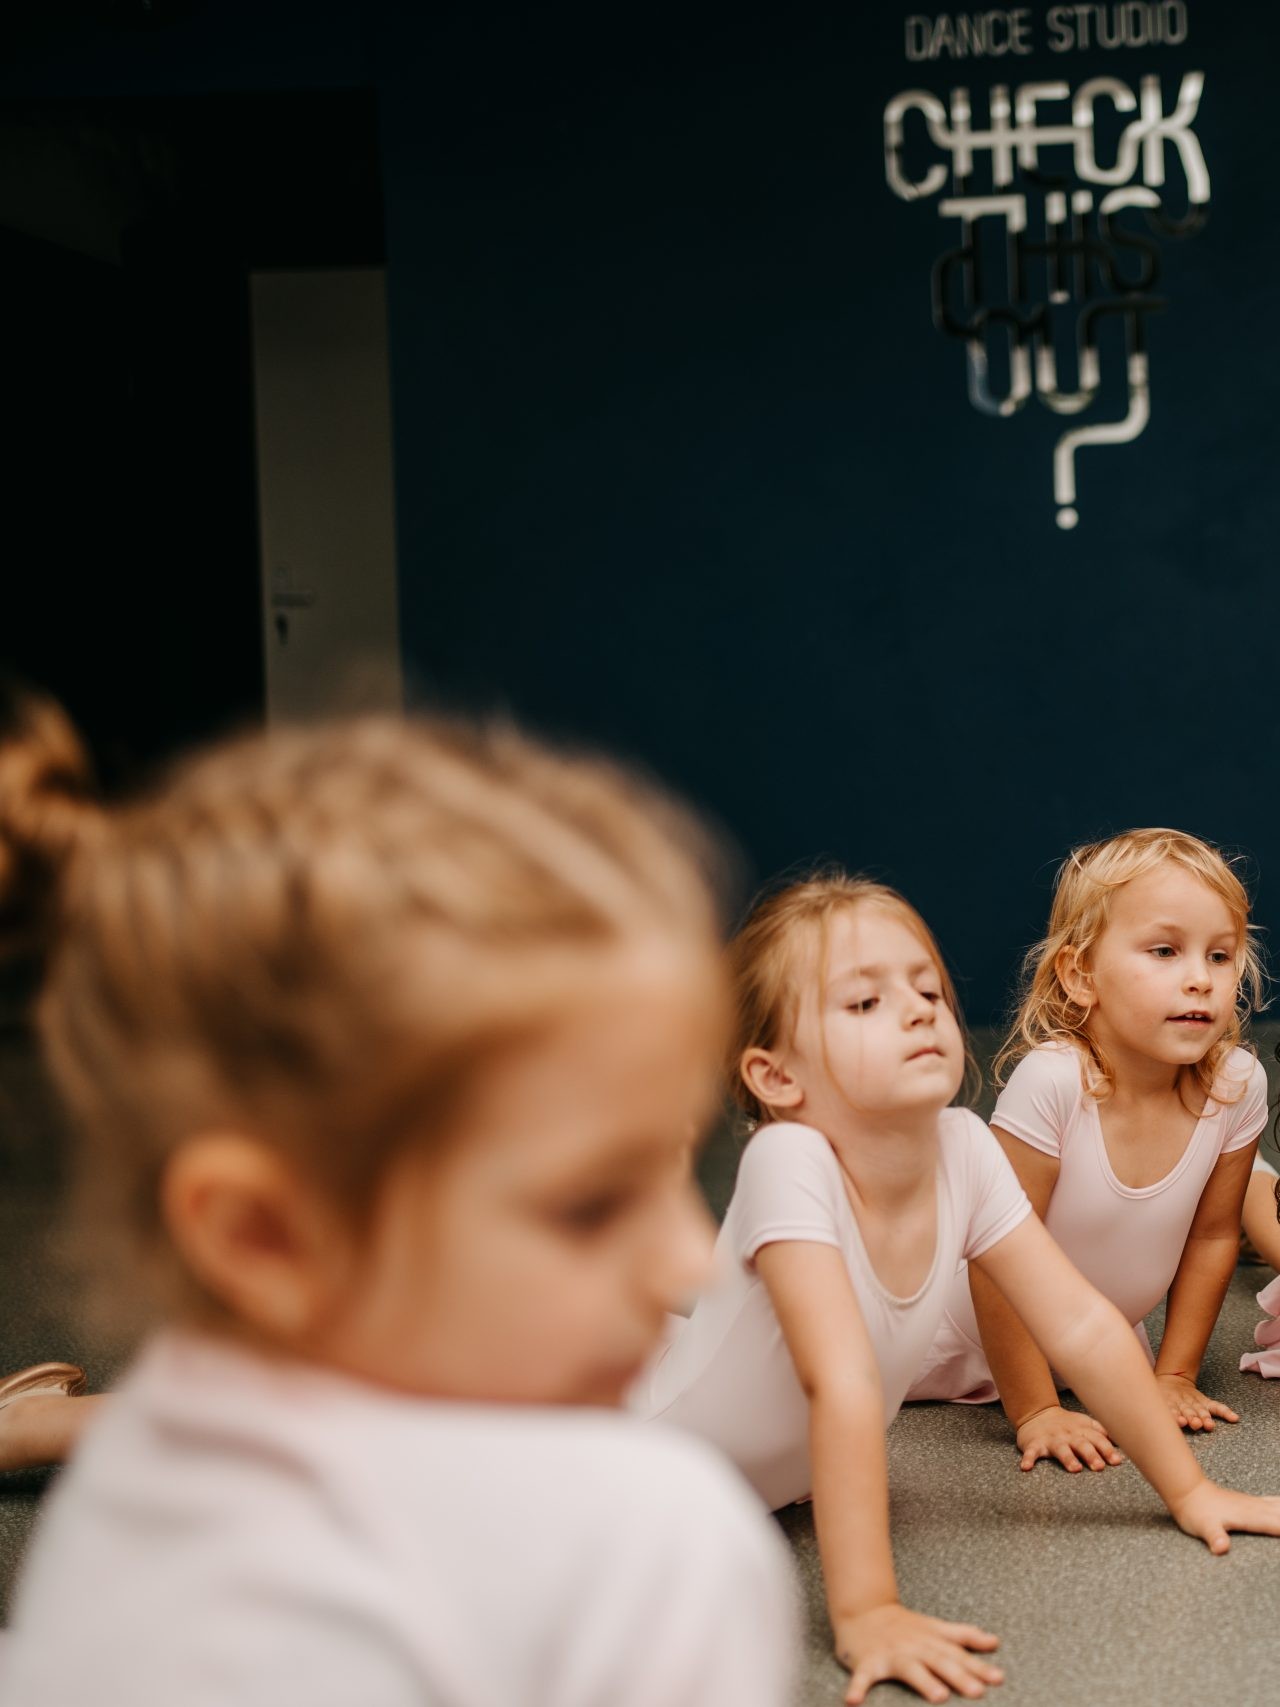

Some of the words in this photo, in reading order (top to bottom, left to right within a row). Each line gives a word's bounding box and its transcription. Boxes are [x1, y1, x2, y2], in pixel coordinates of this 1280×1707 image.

[904, 9, 1033, 61] DANCE
[1045, 0, 1189, 53] STUDIO
[883, 70, 1212, 203] CHECK
